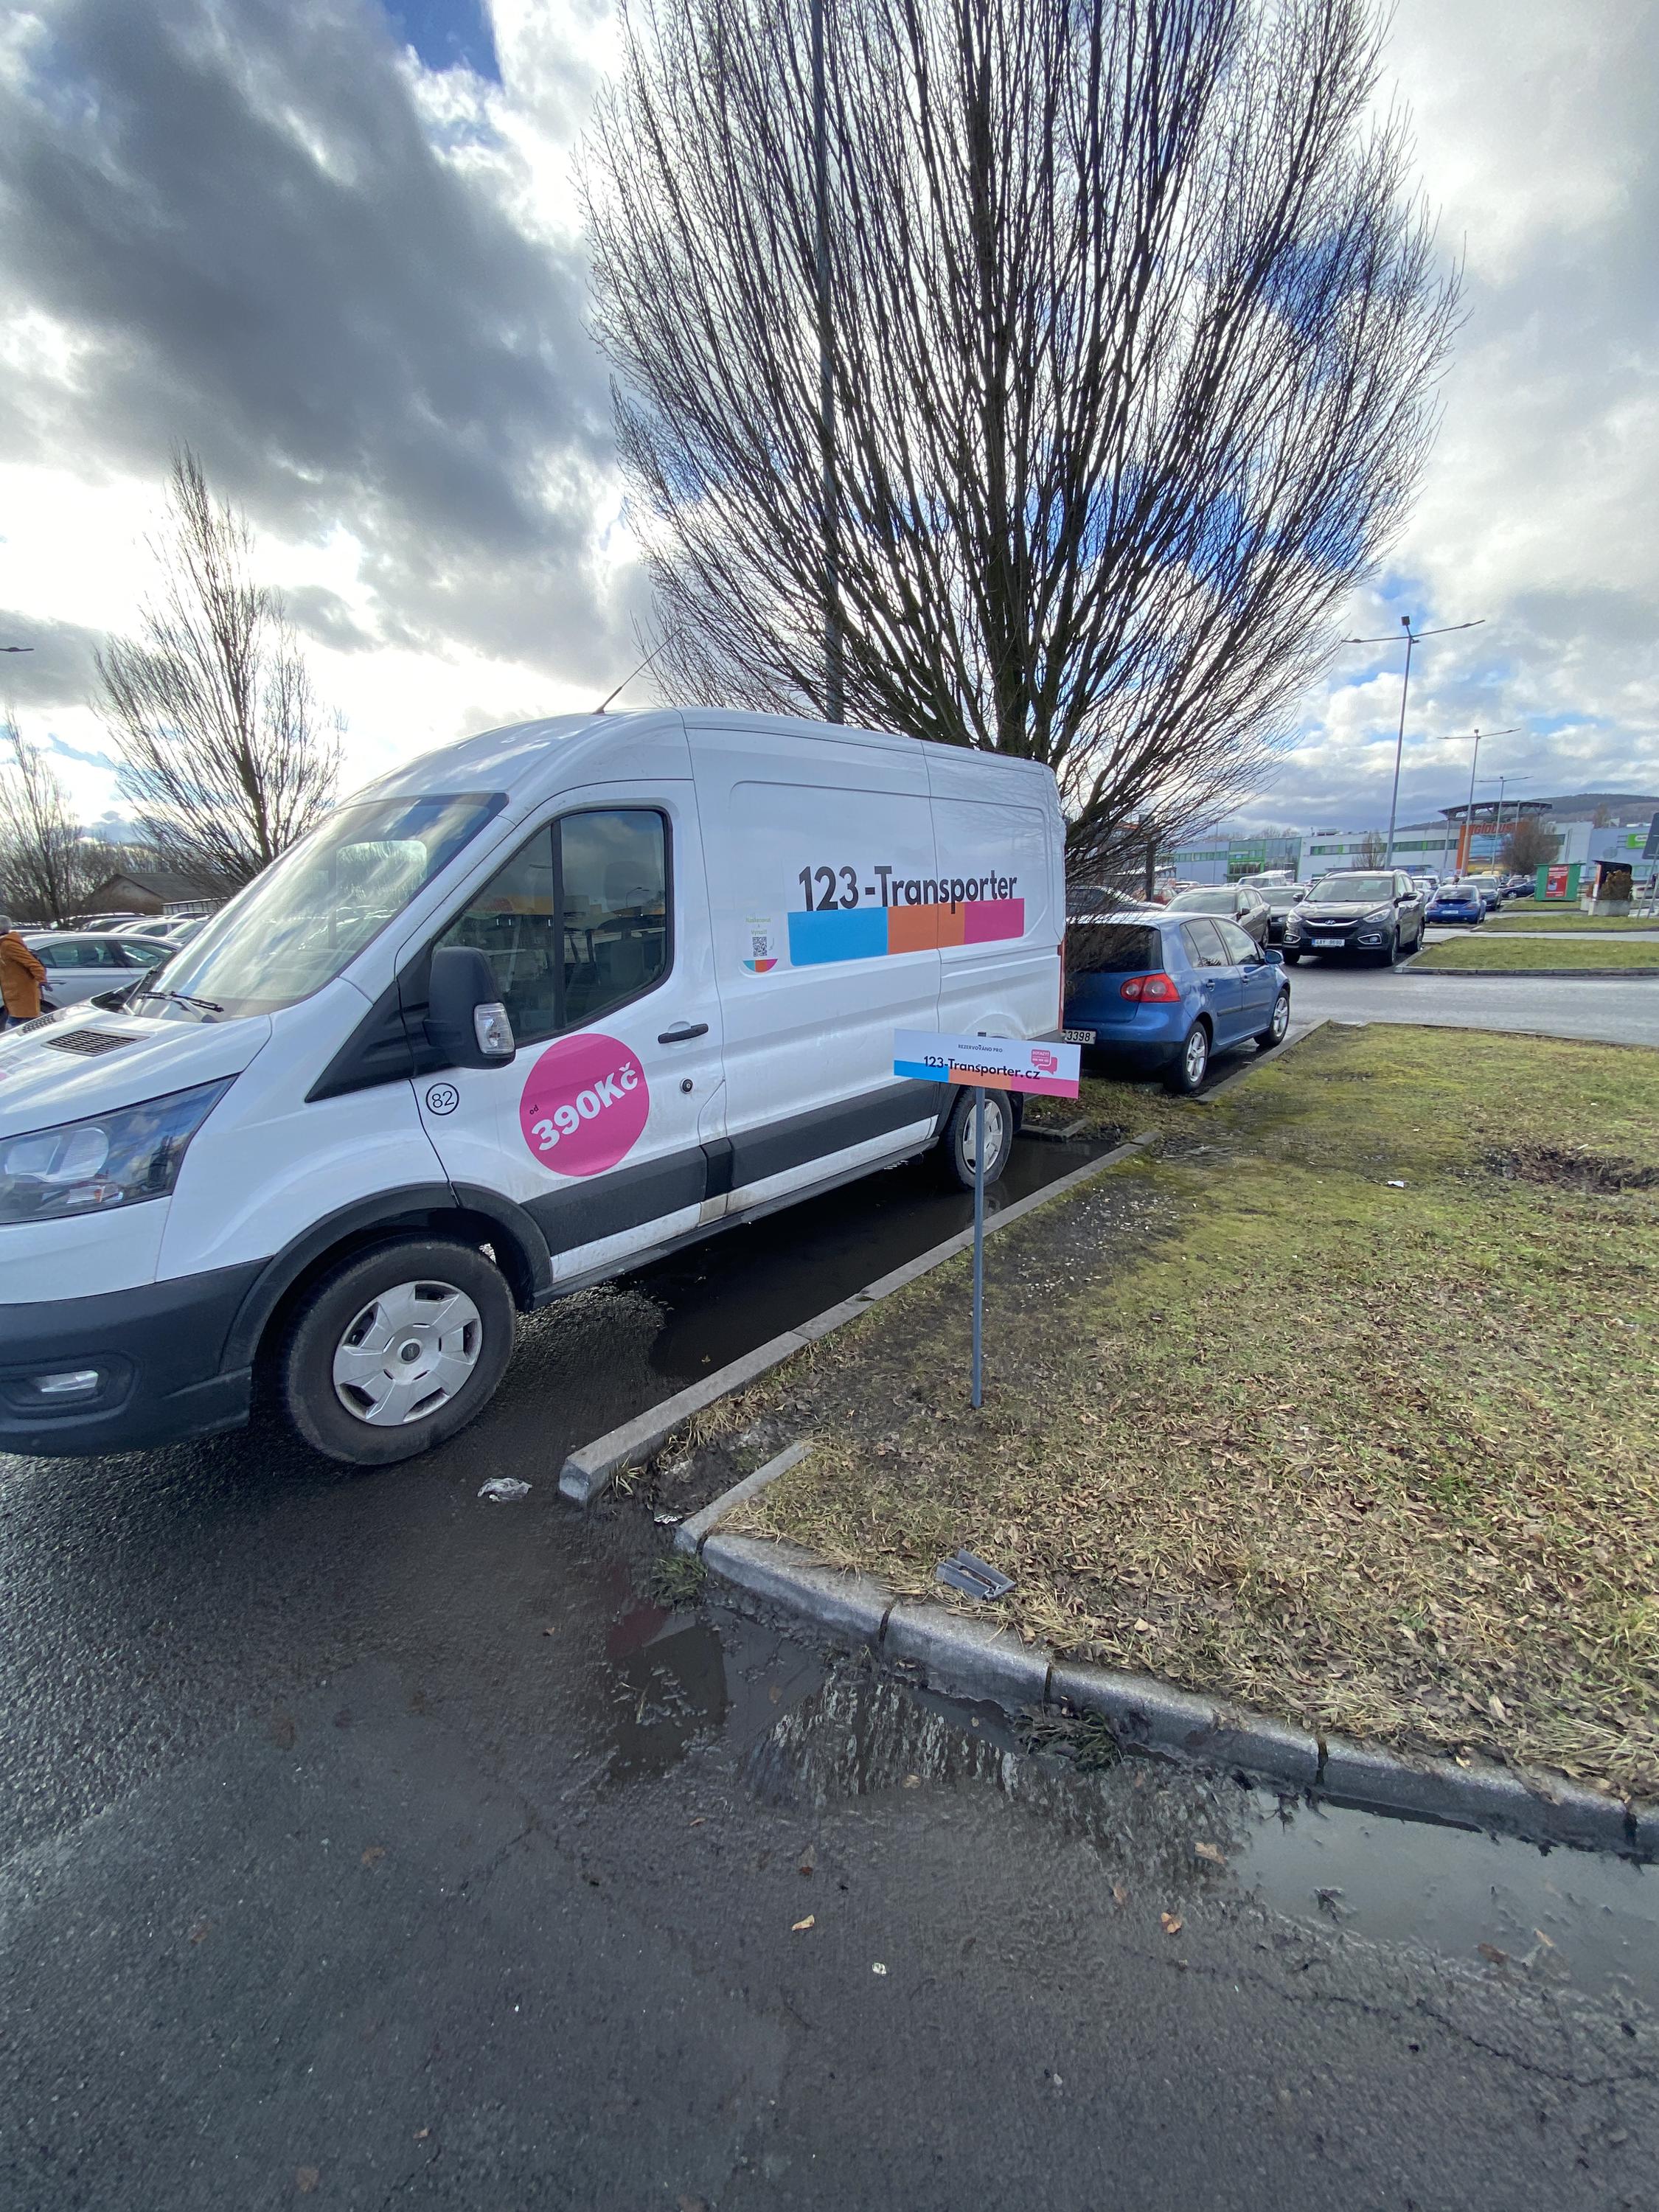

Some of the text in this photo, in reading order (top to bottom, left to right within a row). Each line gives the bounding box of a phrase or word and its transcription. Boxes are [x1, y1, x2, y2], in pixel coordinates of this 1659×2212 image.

[799, 865, 1018, 915] 123-Transporter
[923, 1055, 1040, 1080] 123-Transporter.cz
[431, 1090, 455, 1109] 82
[529, 1105, 539, 1115] od
[531, 1062, 639, 1151] 390Kč
